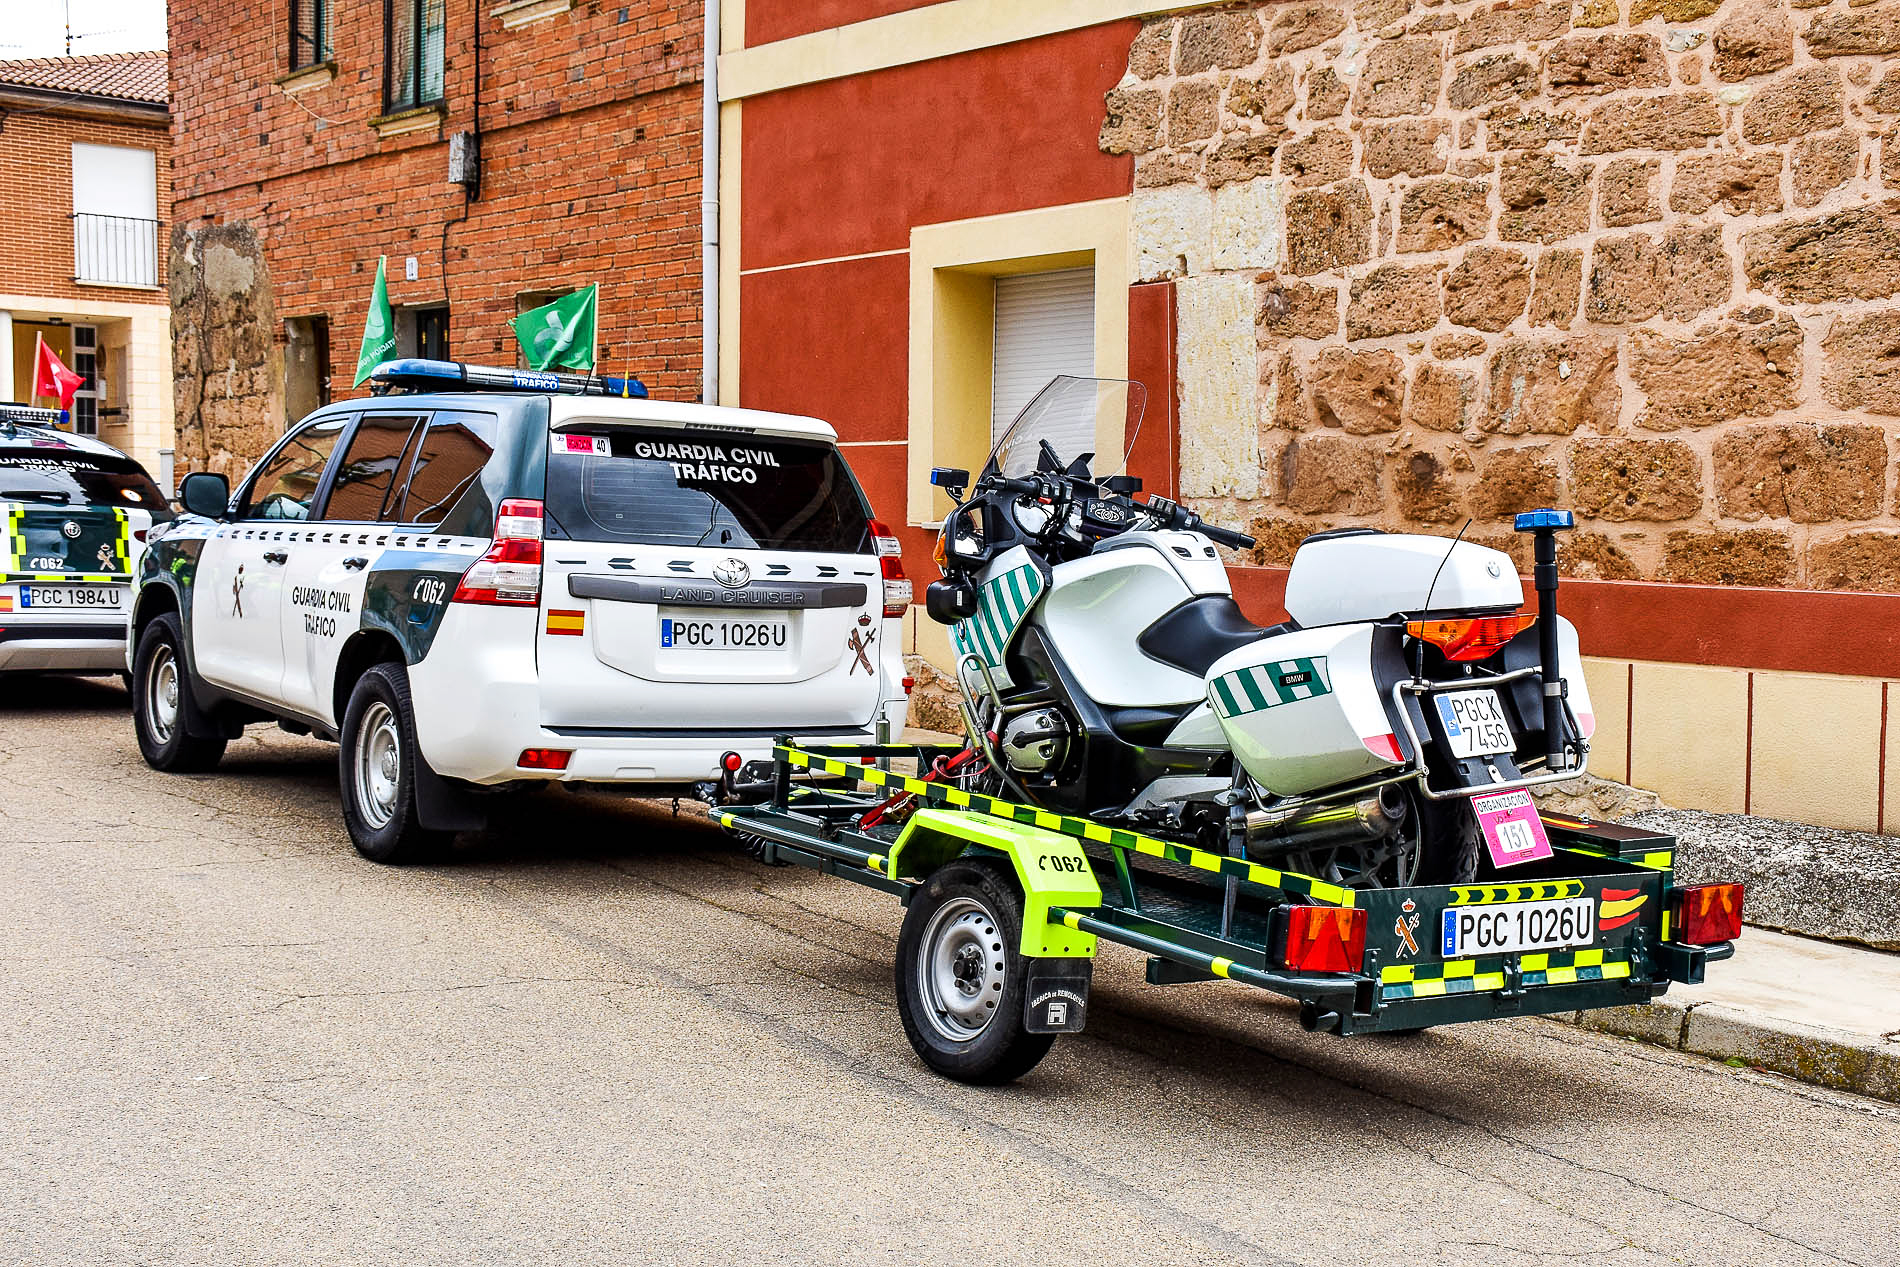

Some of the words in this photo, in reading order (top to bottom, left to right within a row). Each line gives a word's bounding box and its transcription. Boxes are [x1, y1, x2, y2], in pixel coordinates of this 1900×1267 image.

[516, 378, 558, 389] TRAFICO
[597, 440, 606, 452] 40
[635, 442, 728, 462] GUARDIA
[730, 448, 780, 468] CIVIL
[0, 458, 59, 466] UARDIA
[62, 460, 100, 471] CIVIL
[669, 461, 758, 484] TRÁFICO
[40, 556, 64, 570] 062
[31, 589, 62, 604] PGC
[292, 586, 326, 609] GUARDIA
[328, 590, 351, 613] CIVIL
[422, 578, 446, 605] 062
[660, 587, 715, 601] LAND
[721, 590, 805, 605] CRUISER
[673, 622, 713, 645] PGC
[1285, 673, 1304, 684] BMW
[1452, 695, 1502, 724] PGCK
[1462, 723, 1509, 752] 7456
[1503, 823, 1529, 849] 151
[1051, 855, 1087, 873] 062
[1460, 911, 1508, 949] PGC
